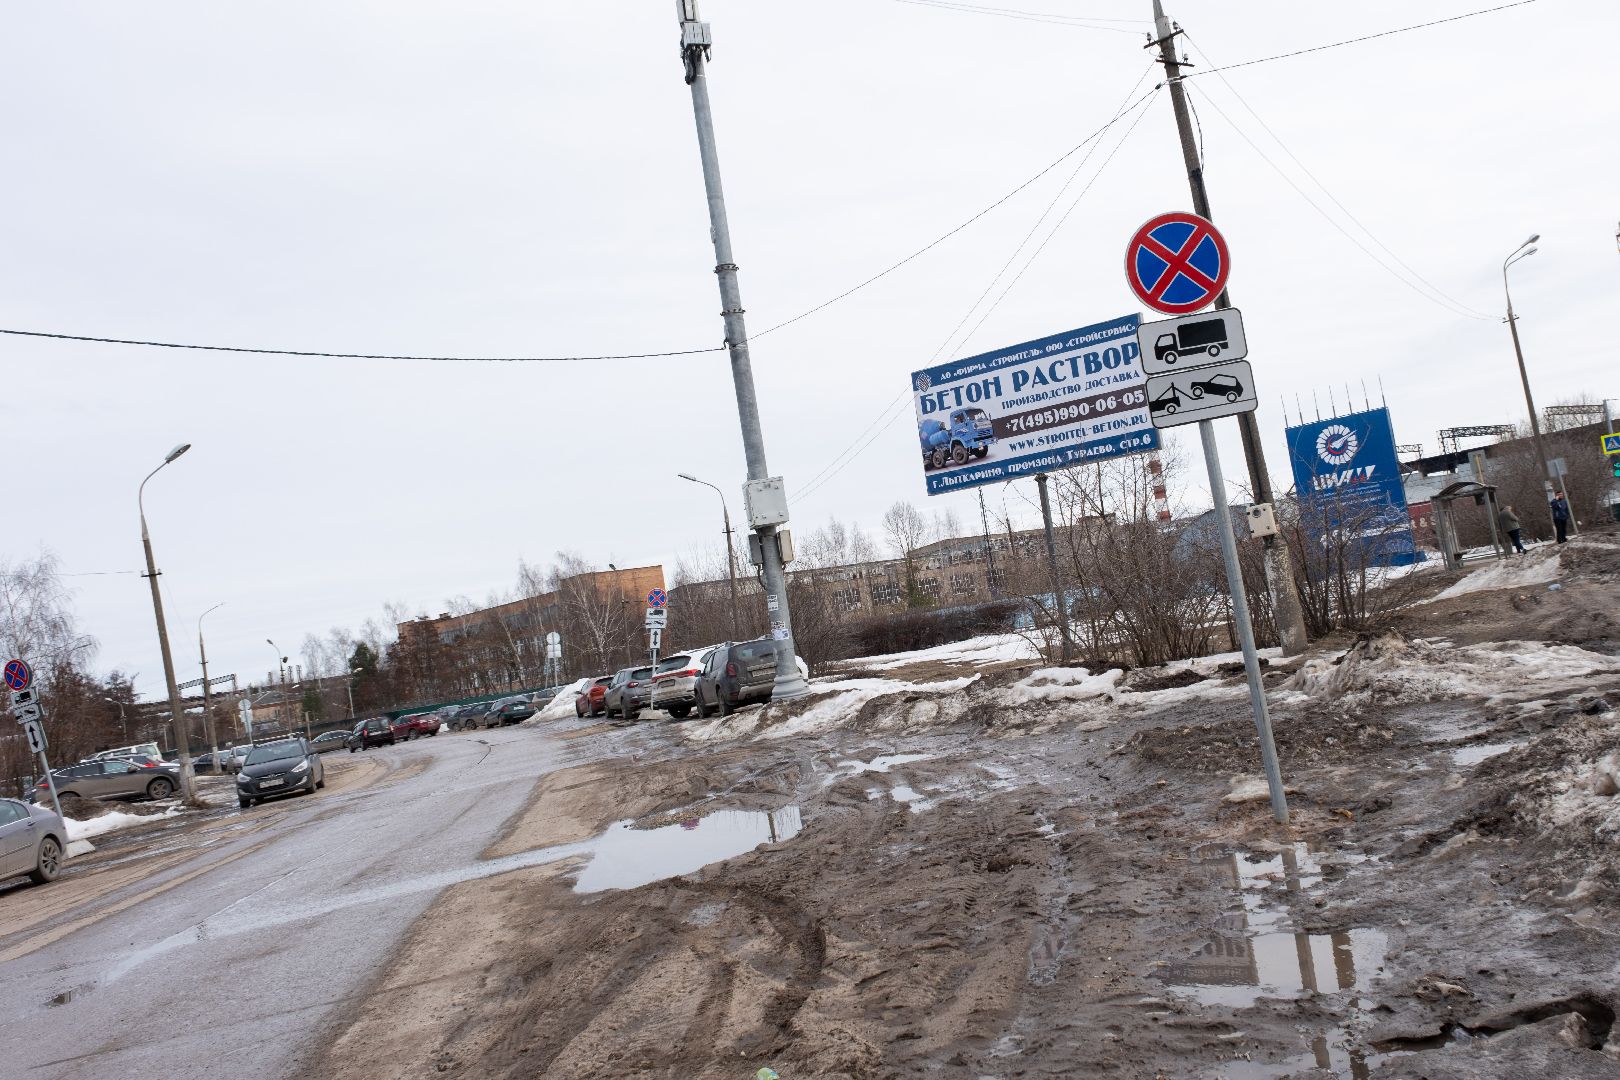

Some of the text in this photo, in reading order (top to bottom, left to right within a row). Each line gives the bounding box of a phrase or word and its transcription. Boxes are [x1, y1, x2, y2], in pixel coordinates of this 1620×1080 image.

[940, 371, 951, 381] АО
[1045, 342, 1063, 353] ООО
[1065, 324, 1136, 347] «СТРОЙСЕРВИС»
[920, 342, 1138, 414] БЕТОН РАСТВОР
[1002, 370, 1140, 409] ПРОИЗВОДСТВО ДОСТАВКА
[1006, 389, 1145, 432] +7(495)990-06-05
